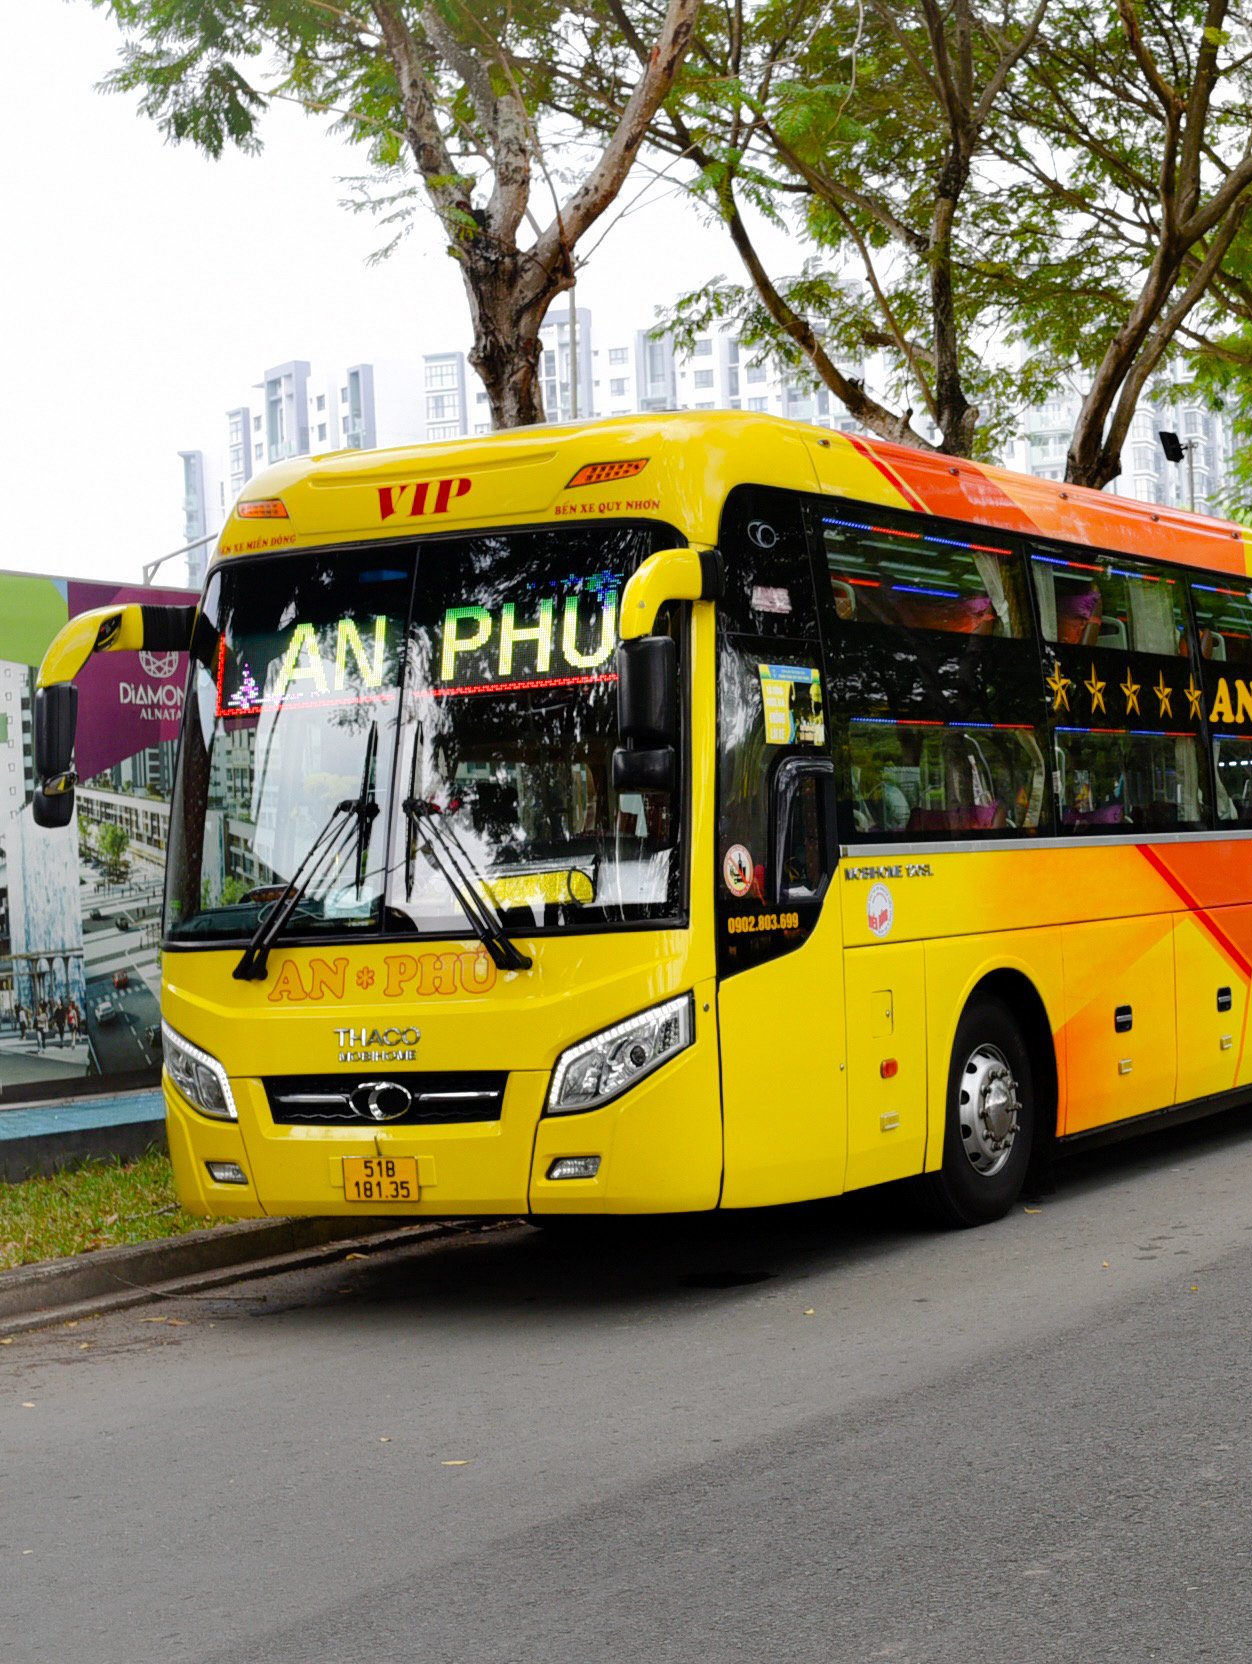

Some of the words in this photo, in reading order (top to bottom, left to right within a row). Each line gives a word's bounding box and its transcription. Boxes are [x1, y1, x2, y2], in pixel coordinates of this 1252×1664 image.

[377, 477, 472, 521] VIP
[580, 503, 595, 513] XE
[598, 501, 622, 514] QUY
[273, 615, 387, 695] AN
[727, 911, 799, 934] 0902.803.699
[268, 957, 349, 1001] AN
[332, 1025, 421, 1048] THACO
[363, 1159, 395, 1178] 51B
[354, 1180, 411, 1199] 181.35
